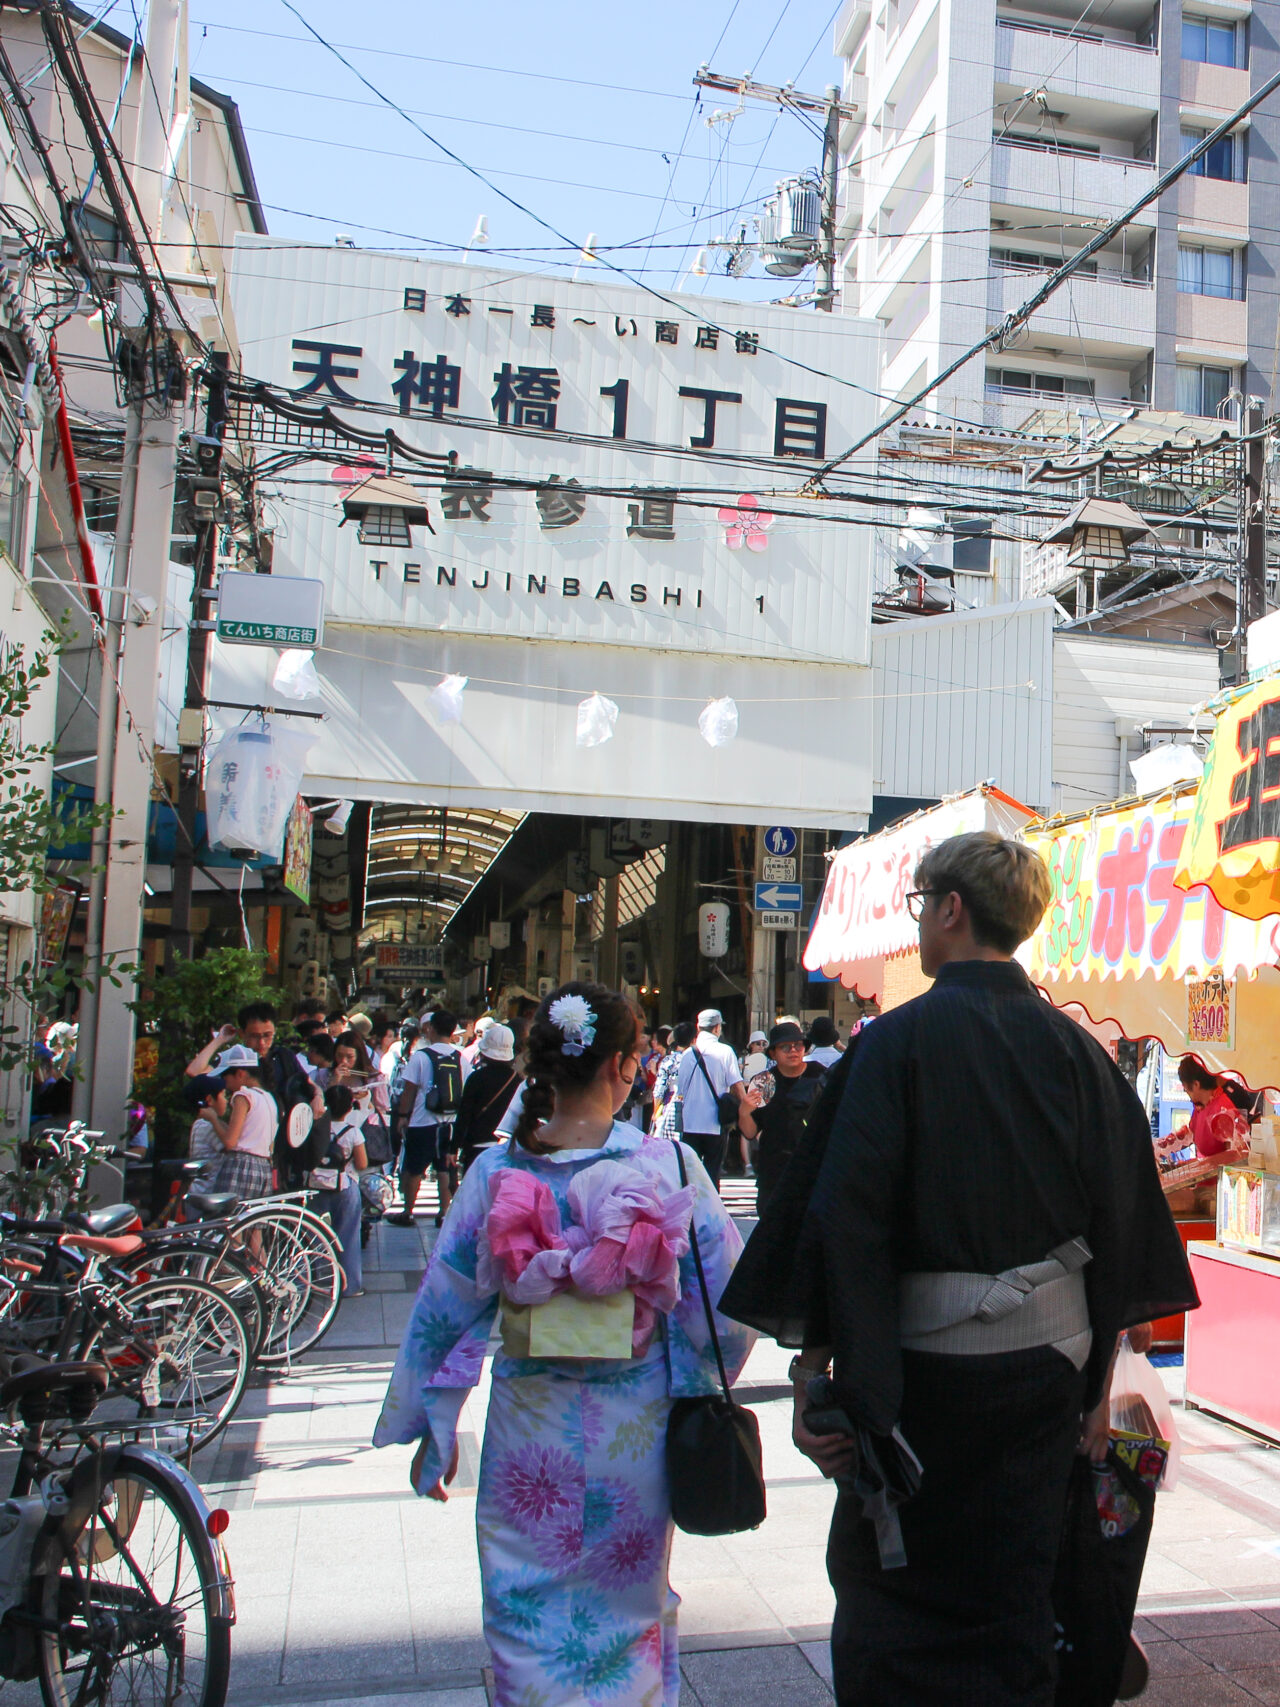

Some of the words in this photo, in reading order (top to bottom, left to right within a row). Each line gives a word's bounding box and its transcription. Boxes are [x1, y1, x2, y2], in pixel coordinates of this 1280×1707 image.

[440, 466, 676, 541] 表参道
[370, 559, 703, 609] TENJINBASHI
[754, 594, 766, 615] 1
[222, 620, 315, 645] てんいち商店街
[1192, 1004, 1225, 1038] ¥500
